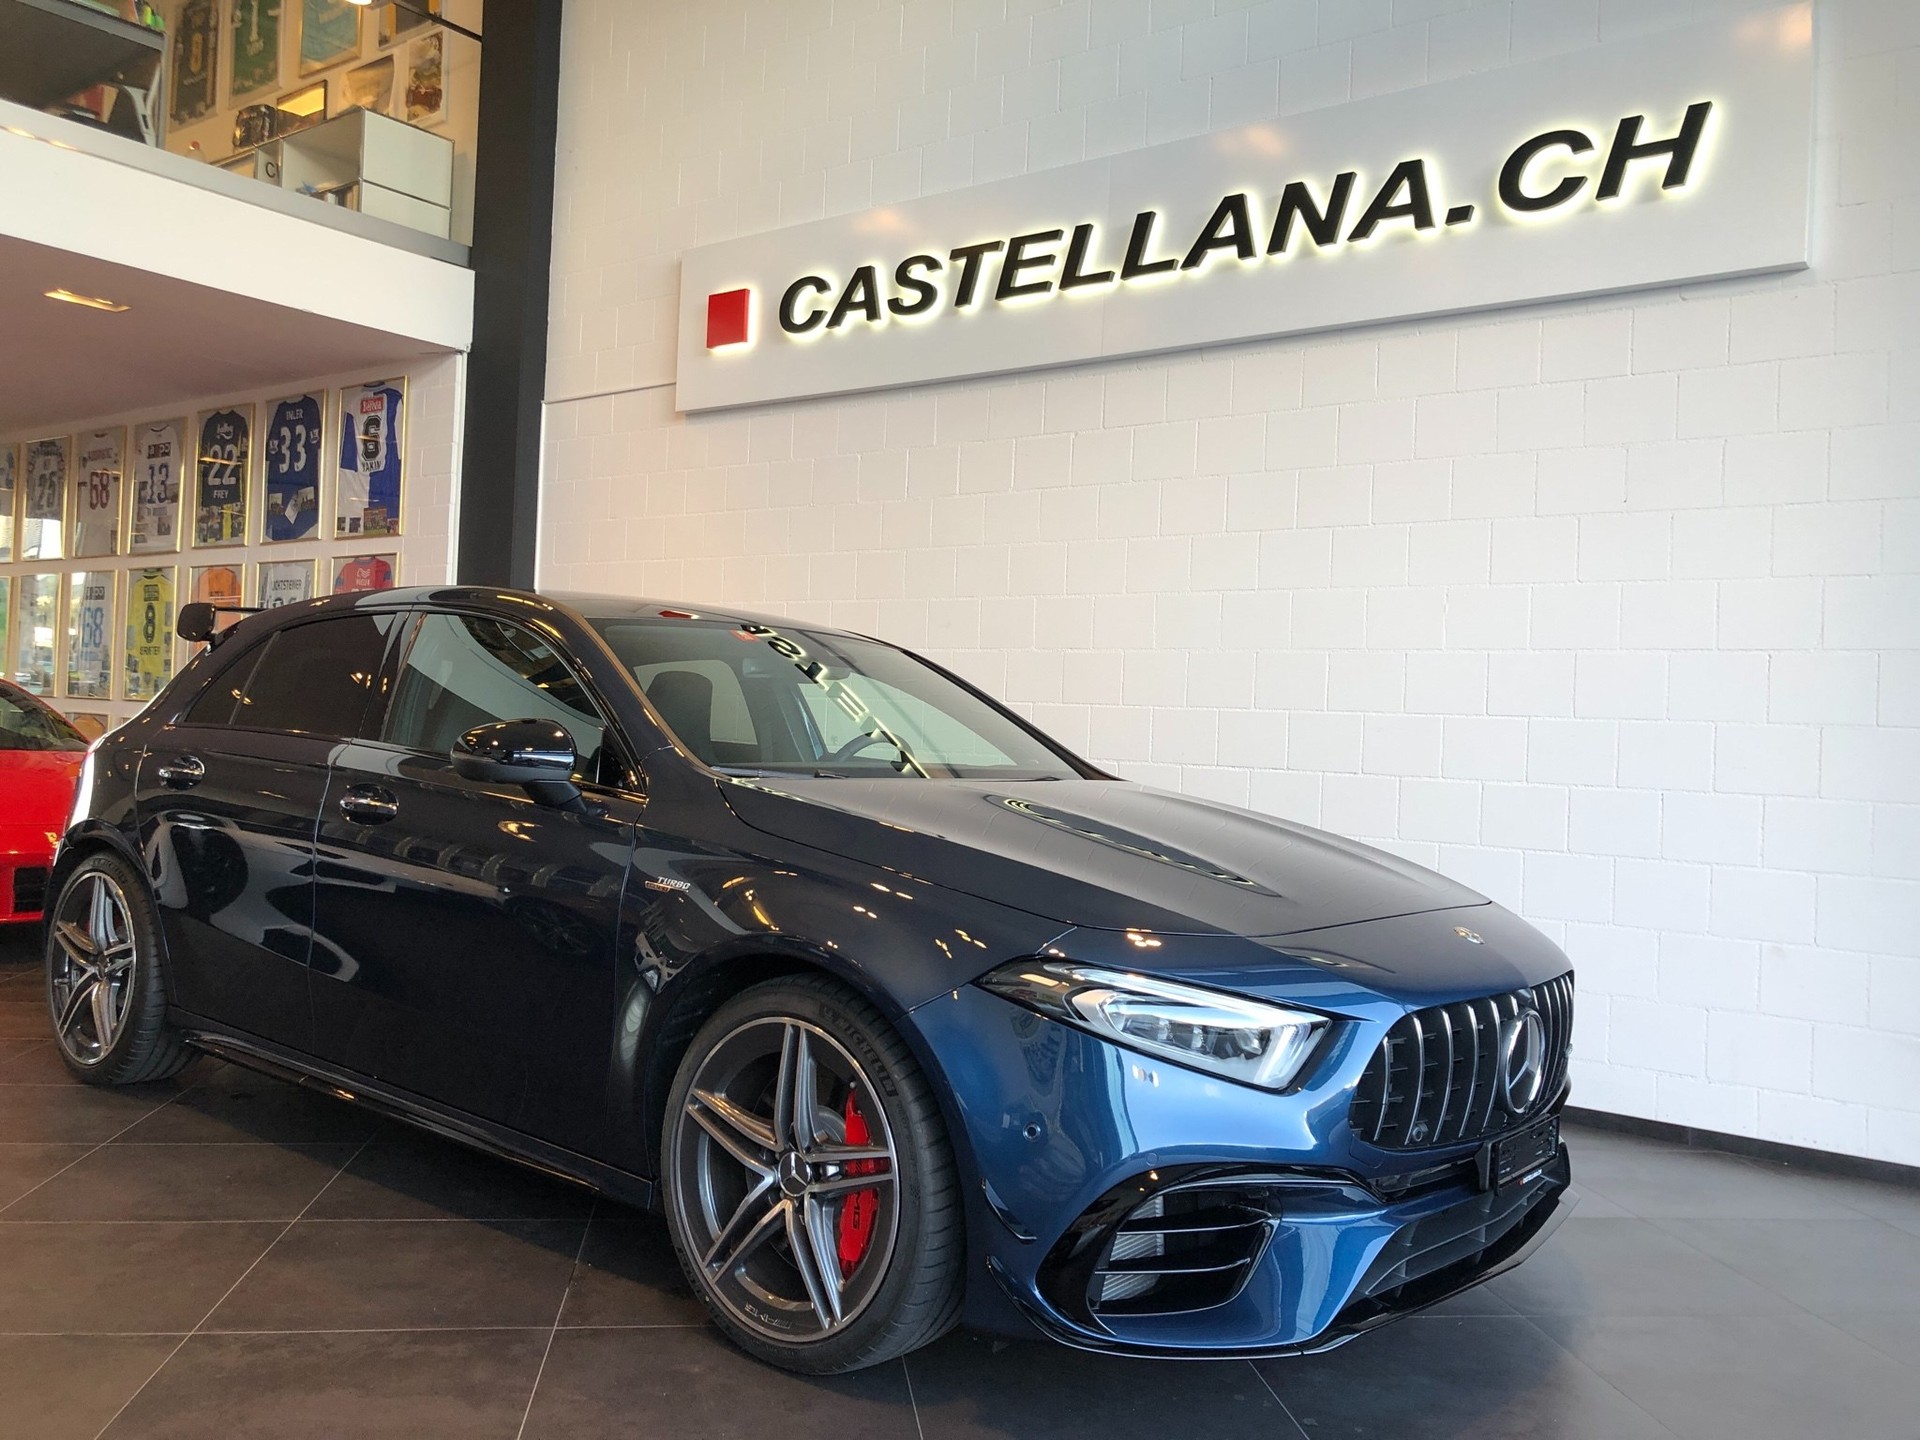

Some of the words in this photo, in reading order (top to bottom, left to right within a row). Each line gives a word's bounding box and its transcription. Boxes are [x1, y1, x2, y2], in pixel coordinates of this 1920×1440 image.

[778, 100, 1713, 333] CASTELLANA.CH
[279, 424, 307, 473] 33
[361, 414, 382, 462] 6
[147, 462, 169, 504] 13
[207, 443, 238, 486] 22
[213, 489, 229, 499] FREY
[143, 602, 156, 643] 8
[657, 876, 691, 890] TURBO
[831, 1011, 898, 1095] MICHELIN
